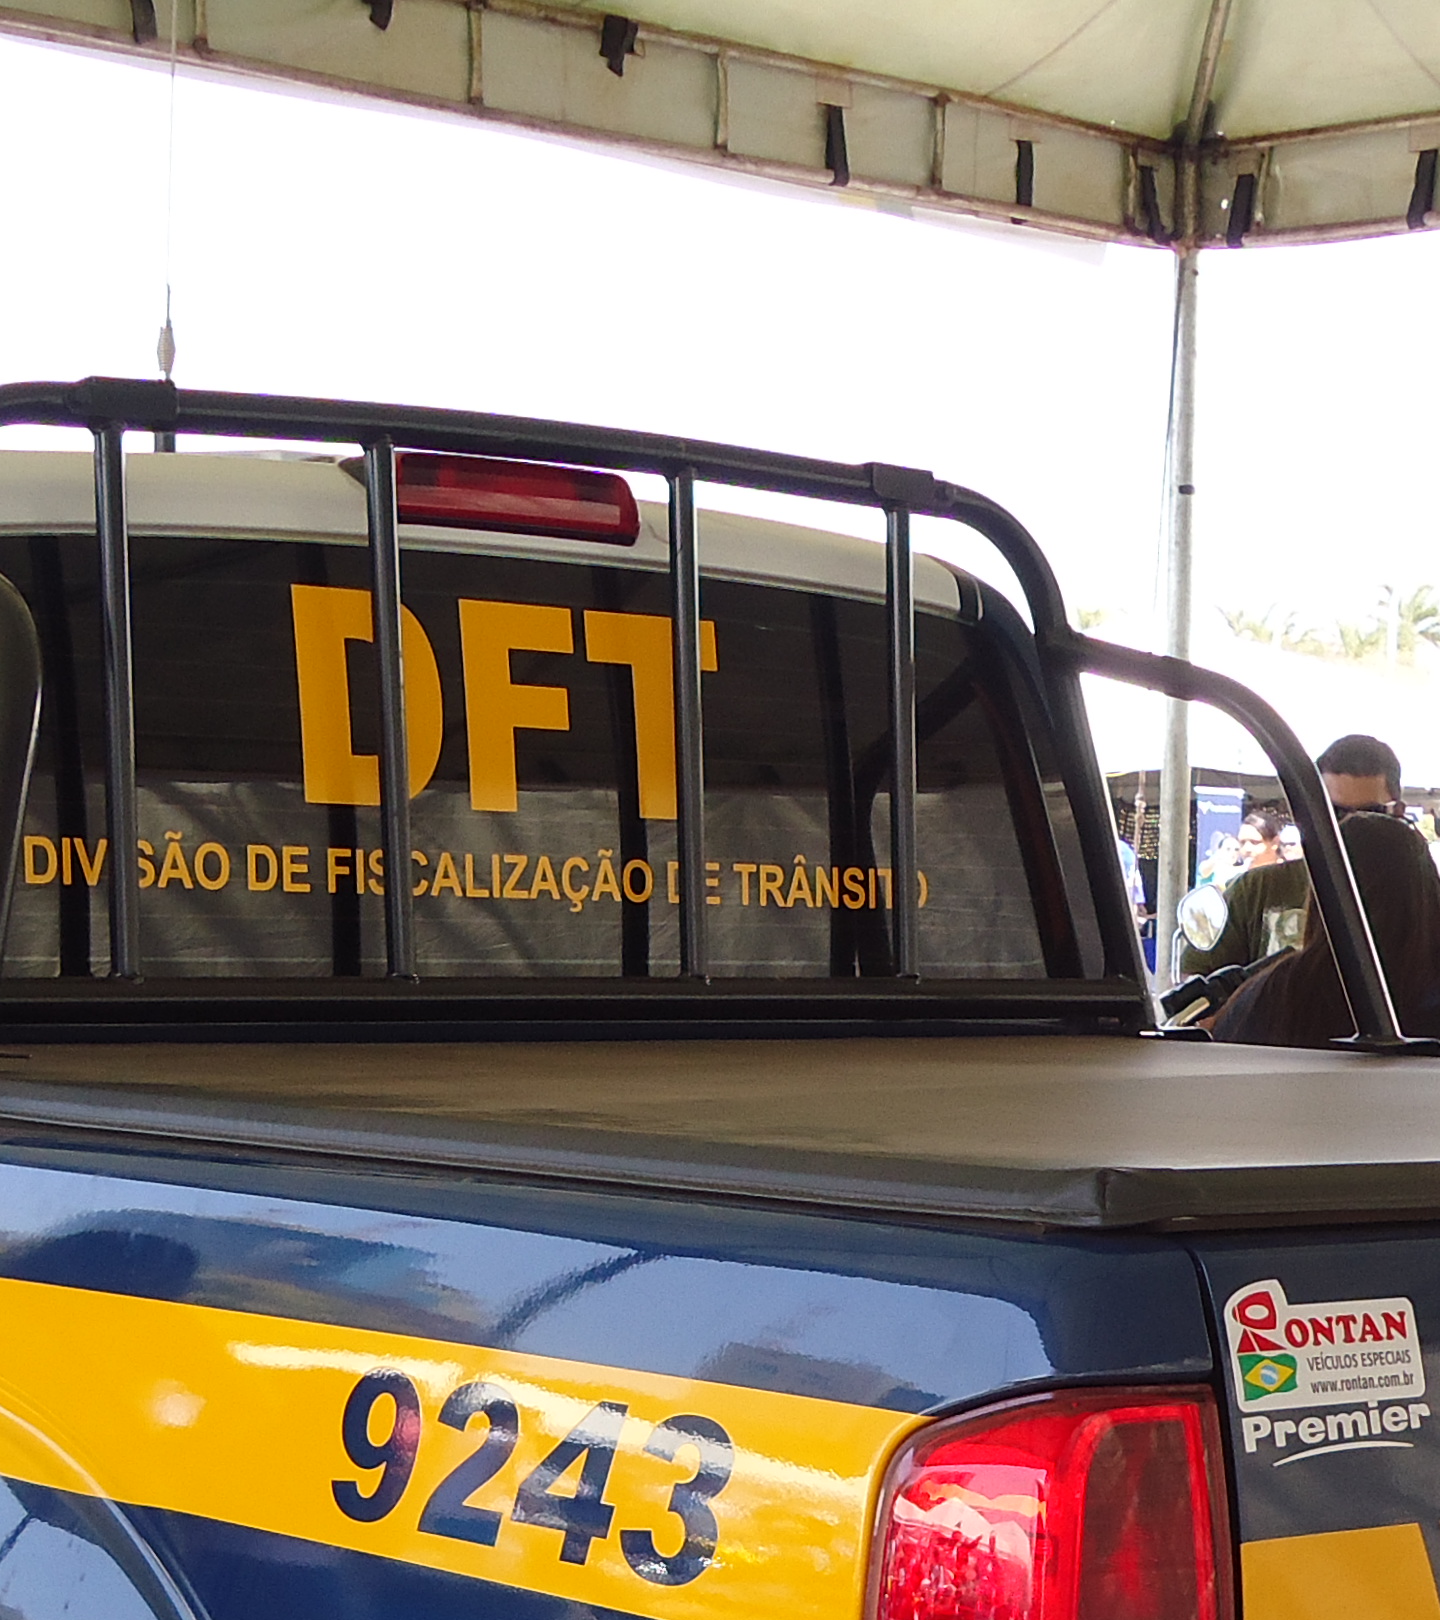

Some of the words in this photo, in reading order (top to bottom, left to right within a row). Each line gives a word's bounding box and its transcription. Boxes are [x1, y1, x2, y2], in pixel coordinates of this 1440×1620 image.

[291, 584, 718, 820] DFT
[23, 831, 230, 891] DIVSÃO
[246, 843, 312, 893] DE
[327, 846, 653, 912] FISCALIZAÇÃO
[1233, 1291, 1408, 1354] RONTAN
[1307, 1351, 1359, 1372] VEÍCULOS
[1361, 1348, 1412, 1368] ESPECIAIS
[1310, 1370, 1415, 1395] www.rontan.com.br
[1241, 1400, 1431, 1454] Premier
[331, 1367, 736, 1587] 9243
